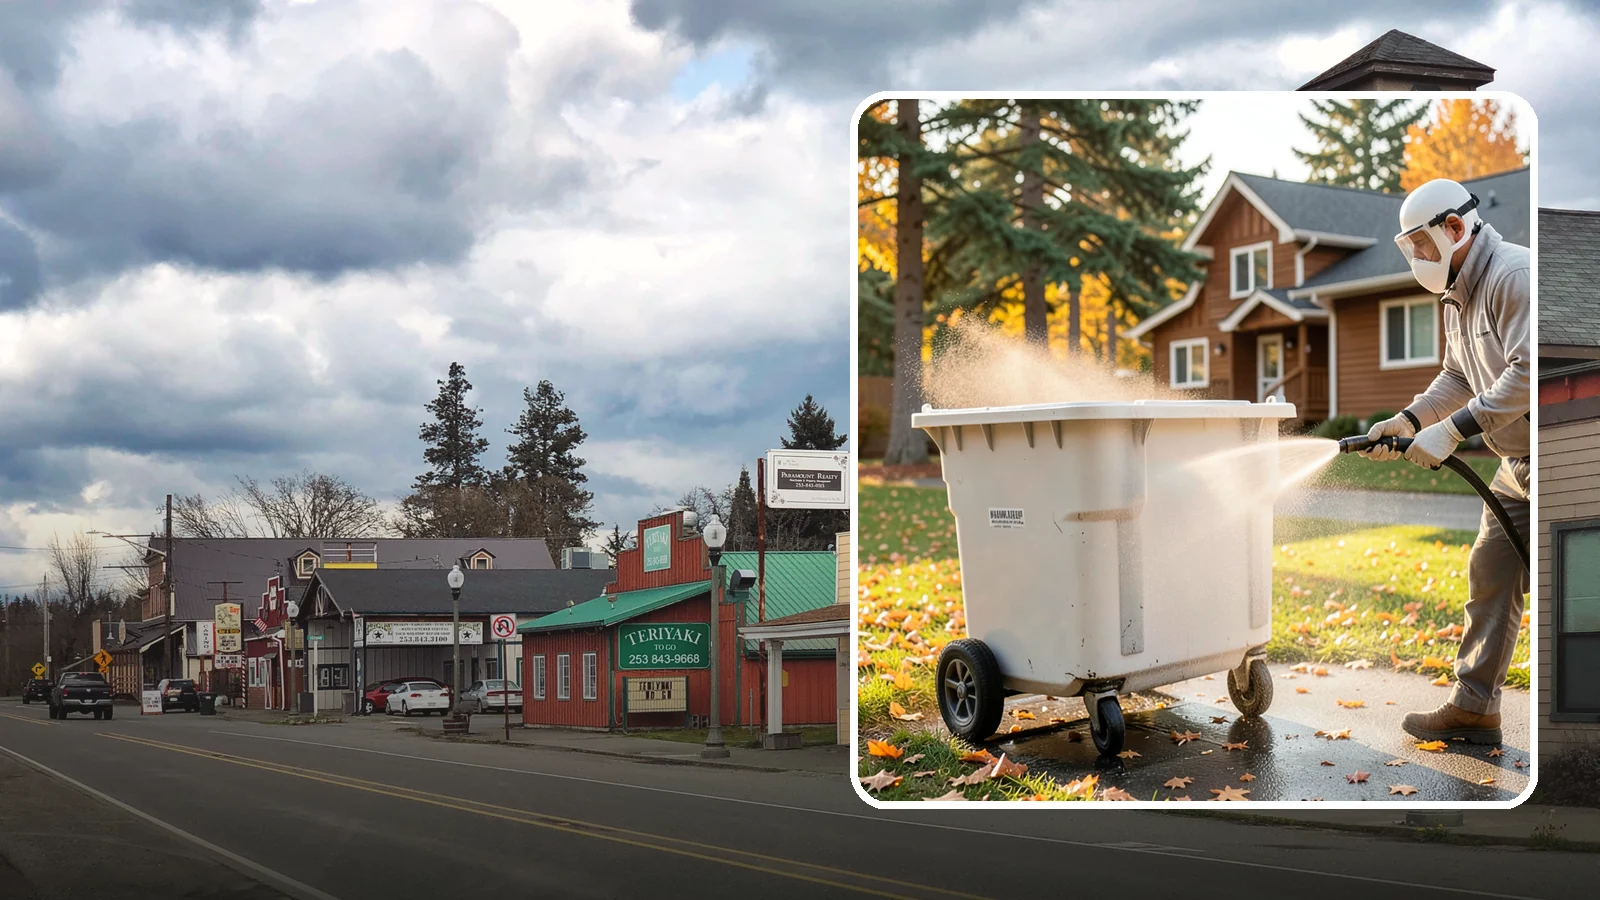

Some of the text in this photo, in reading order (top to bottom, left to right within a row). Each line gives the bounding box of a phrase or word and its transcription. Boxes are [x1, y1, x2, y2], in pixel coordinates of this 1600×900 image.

[624, 627, 702, 646] TERIYAKI
[629, 653, 700, 665] 253 843-9668
